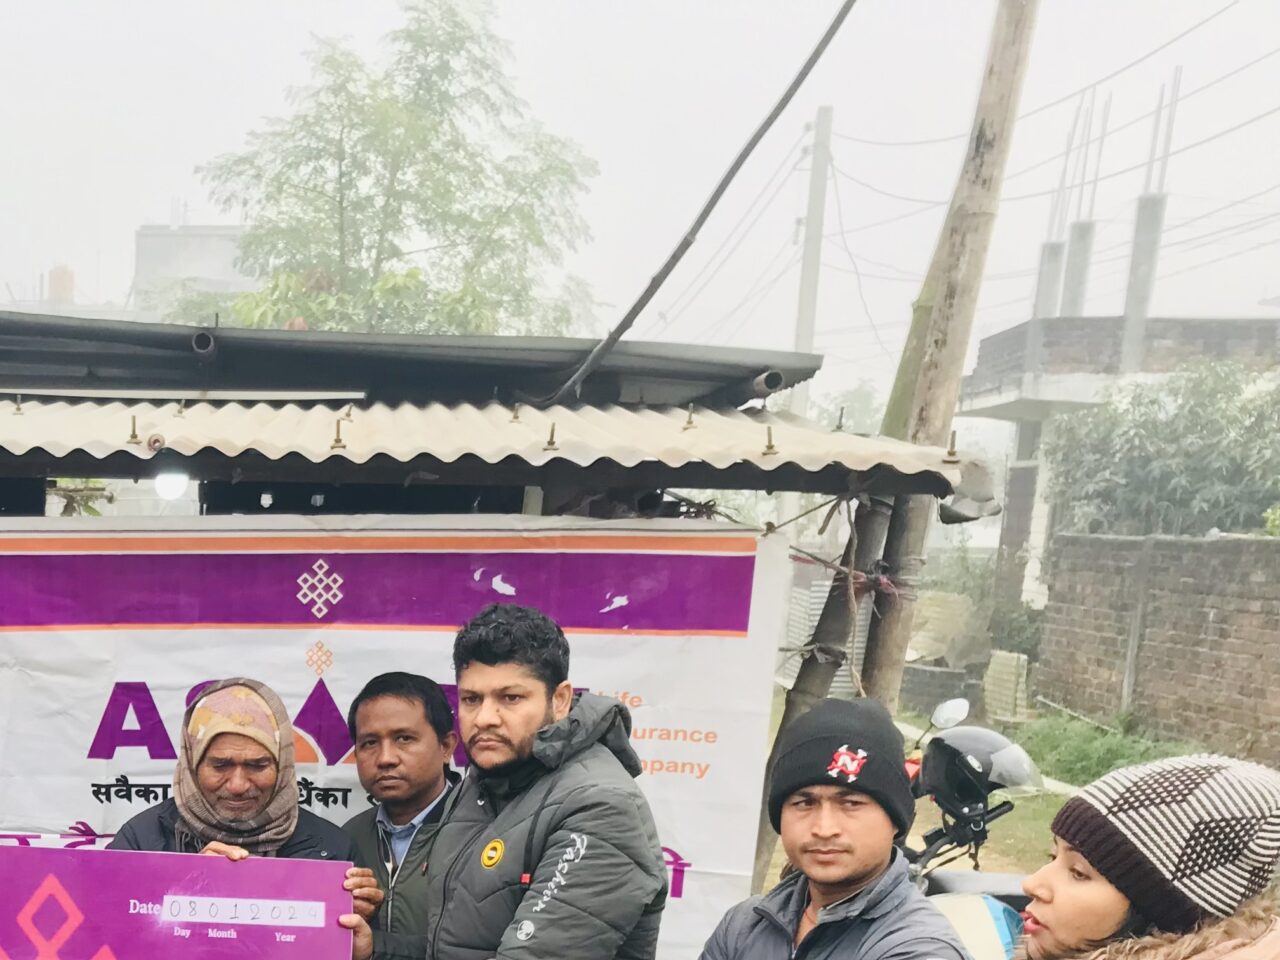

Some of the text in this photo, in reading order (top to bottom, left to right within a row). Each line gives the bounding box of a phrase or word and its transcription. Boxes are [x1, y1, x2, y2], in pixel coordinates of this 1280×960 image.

[632, 726, 718, 743] urance
[629, 758, 710, 779] pany
[127, 899, 161, 915] Date
[173, 926, 297, 942] Day Month Year
